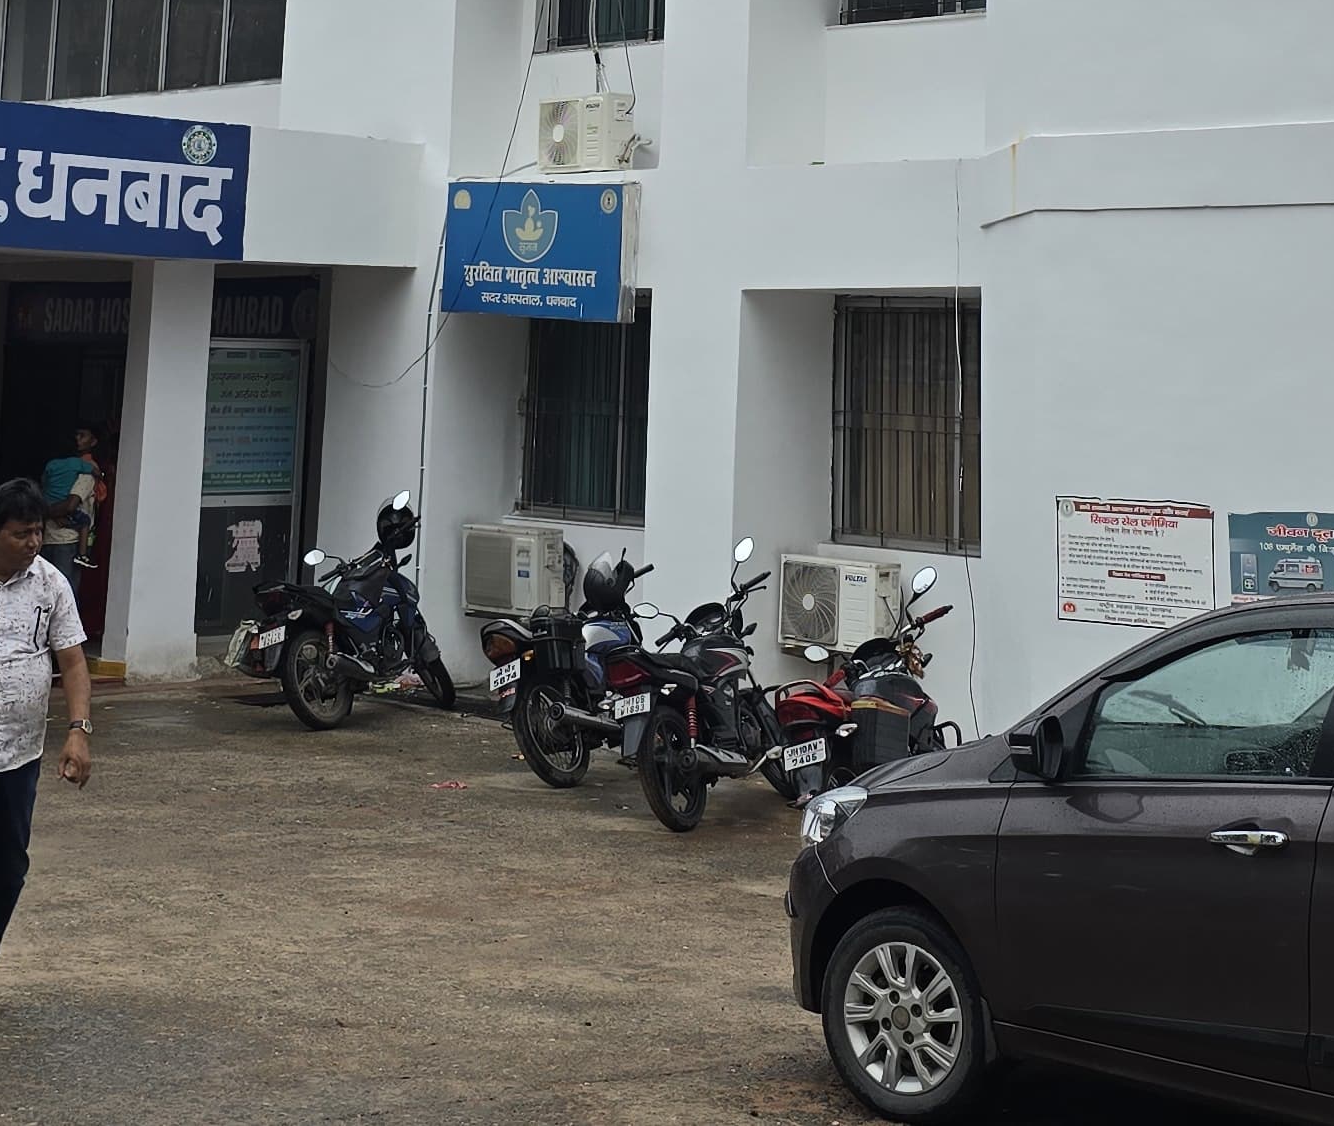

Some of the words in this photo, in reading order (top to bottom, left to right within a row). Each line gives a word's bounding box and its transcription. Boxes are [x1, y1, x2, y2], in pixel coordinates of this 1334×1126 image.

[463, 261, 504, 287] सुरक्षित
[505, 266, 541, 289] मातृत्व
[542, 268, 597, 287] आश्वासन
[481, 292, 502, 303] सदर
[502, 293, 543, 306] अस्पताल,
[43, 297, 94, 333] SADAR
[211, 295, 283, 334] HANBAD
[1266, 524, 1309, 538] जीवन
